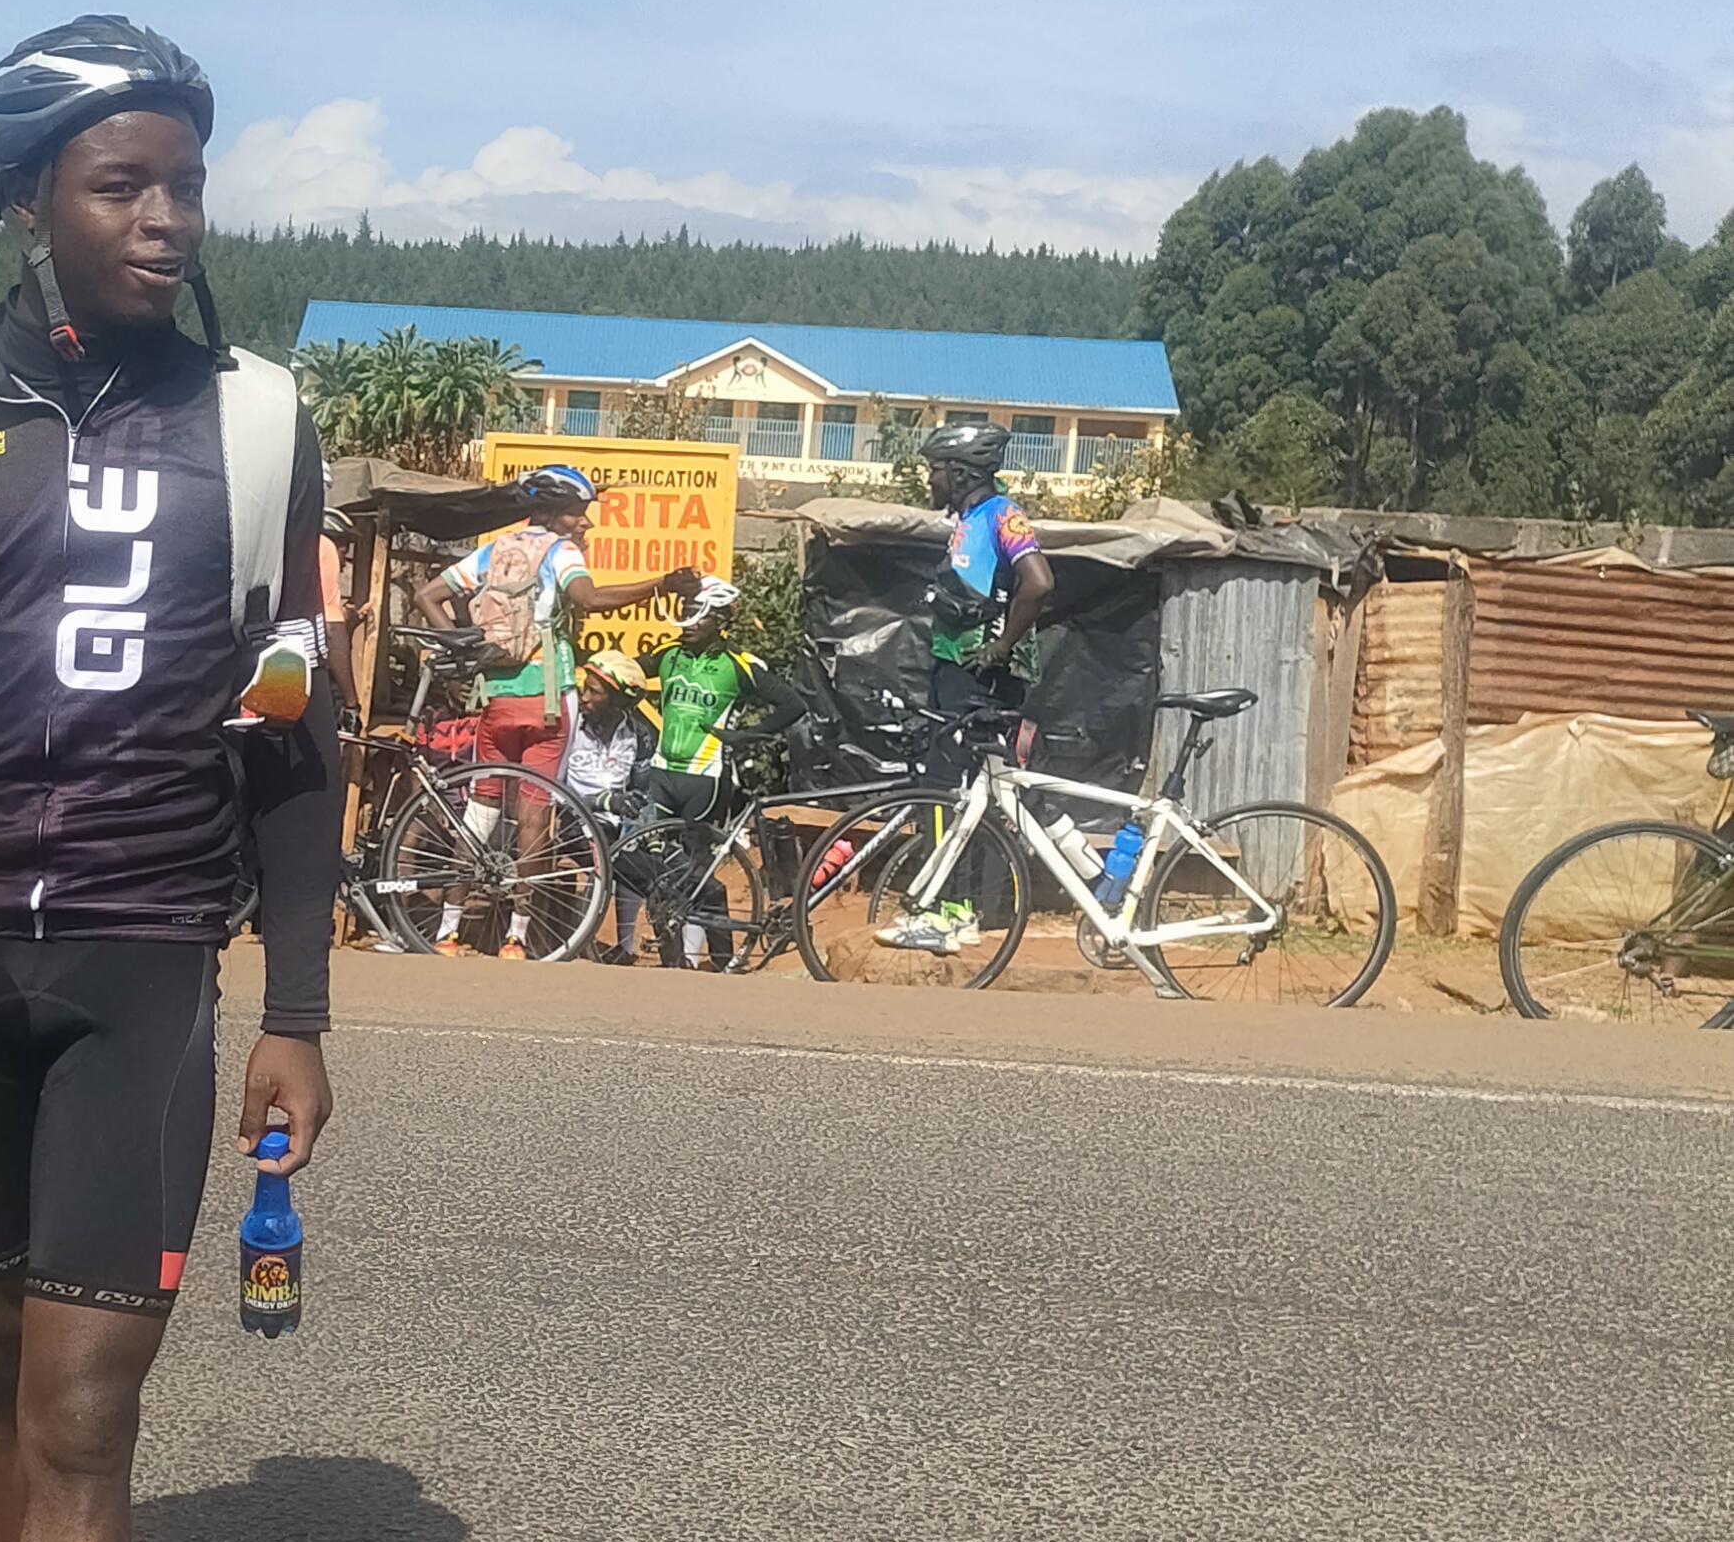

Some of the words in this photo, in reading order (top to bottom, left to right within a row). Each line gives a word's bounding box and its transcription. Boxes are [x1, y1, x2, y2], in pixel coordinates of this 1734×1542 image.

[591, 466, 612, 484] OF
[618, 469, 717, 489] EDUCATION
[599, 492, 711, 530] RITA
[242, 1280, 300, 1302] SIMBA
